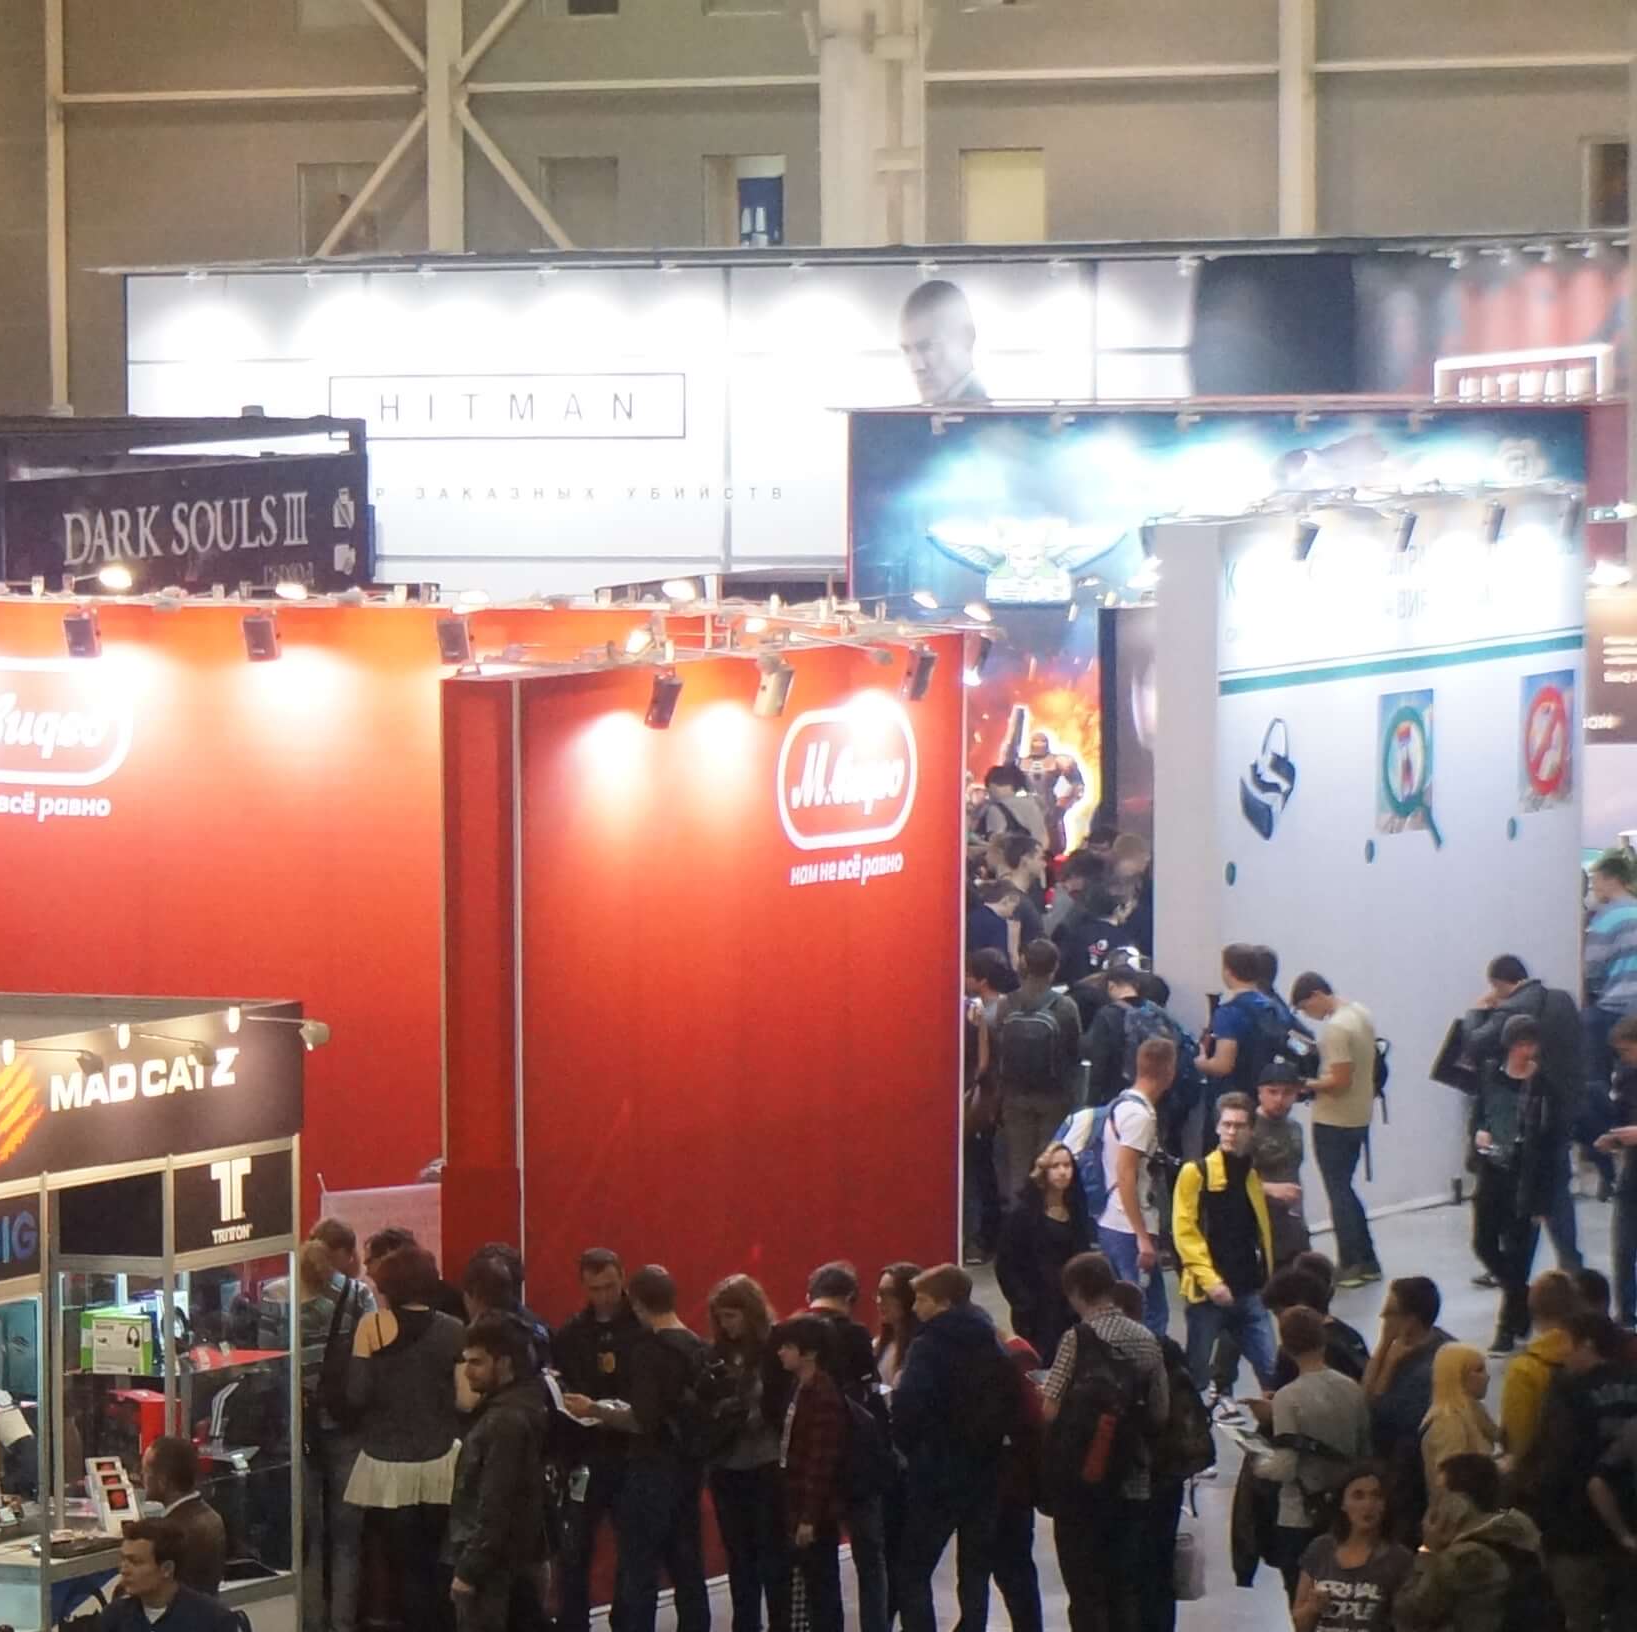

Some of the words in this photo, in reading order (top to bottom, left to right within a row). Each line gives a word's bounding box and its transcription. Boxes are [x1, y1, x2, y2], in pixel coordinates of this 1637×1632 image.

[379, 392, 635, 423] HITMAN
[62, 505, 163, 566] DARK
[171, 494, 278, 556] SOULS
[283, 491, 309, 547] III
[37, 796, 112, 823] равно
[789, 861, 819, 887] нам
[819, 857, 838, 883] не
[837, 851, 862, 881] всё
[860, 851, 904, 886] равно
[50, 1061, 138, 1113] MAD
[141, 1046, 240, 1098] CATZ
